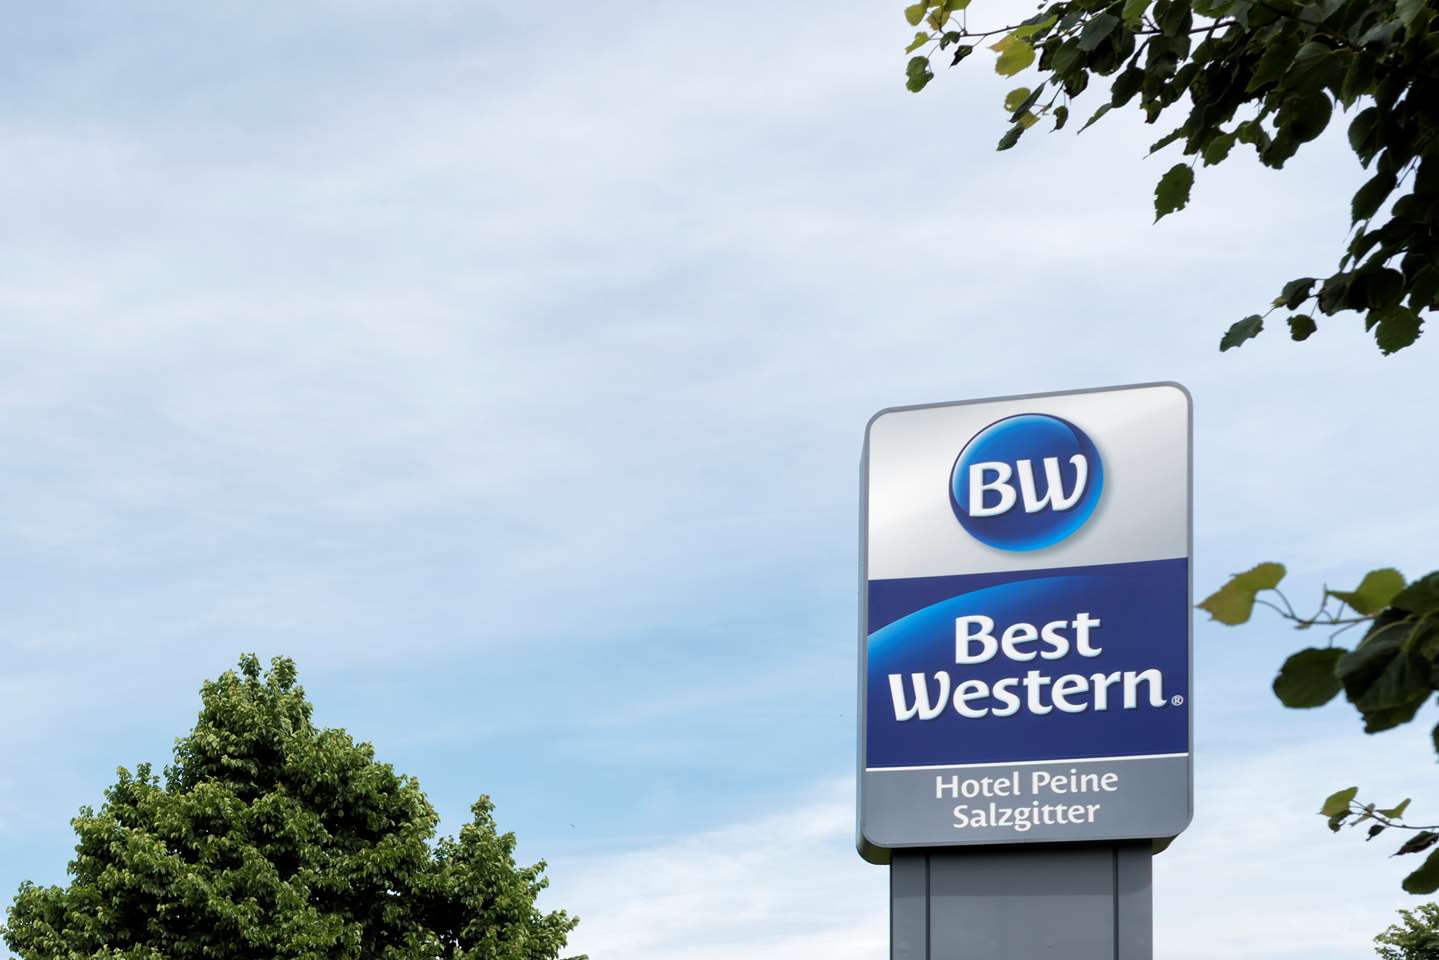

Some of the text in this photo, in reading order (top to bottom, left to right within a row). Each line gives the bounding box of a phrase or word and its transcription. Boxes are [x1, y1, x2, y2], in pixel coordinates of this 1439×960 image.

[969, 454, 1088, 517] BW
[955, 612, 1103, 665] Best
[935, 769, 1118, 799] Hotel Peine
[953, 802, 1100, 831] Salzgitter
